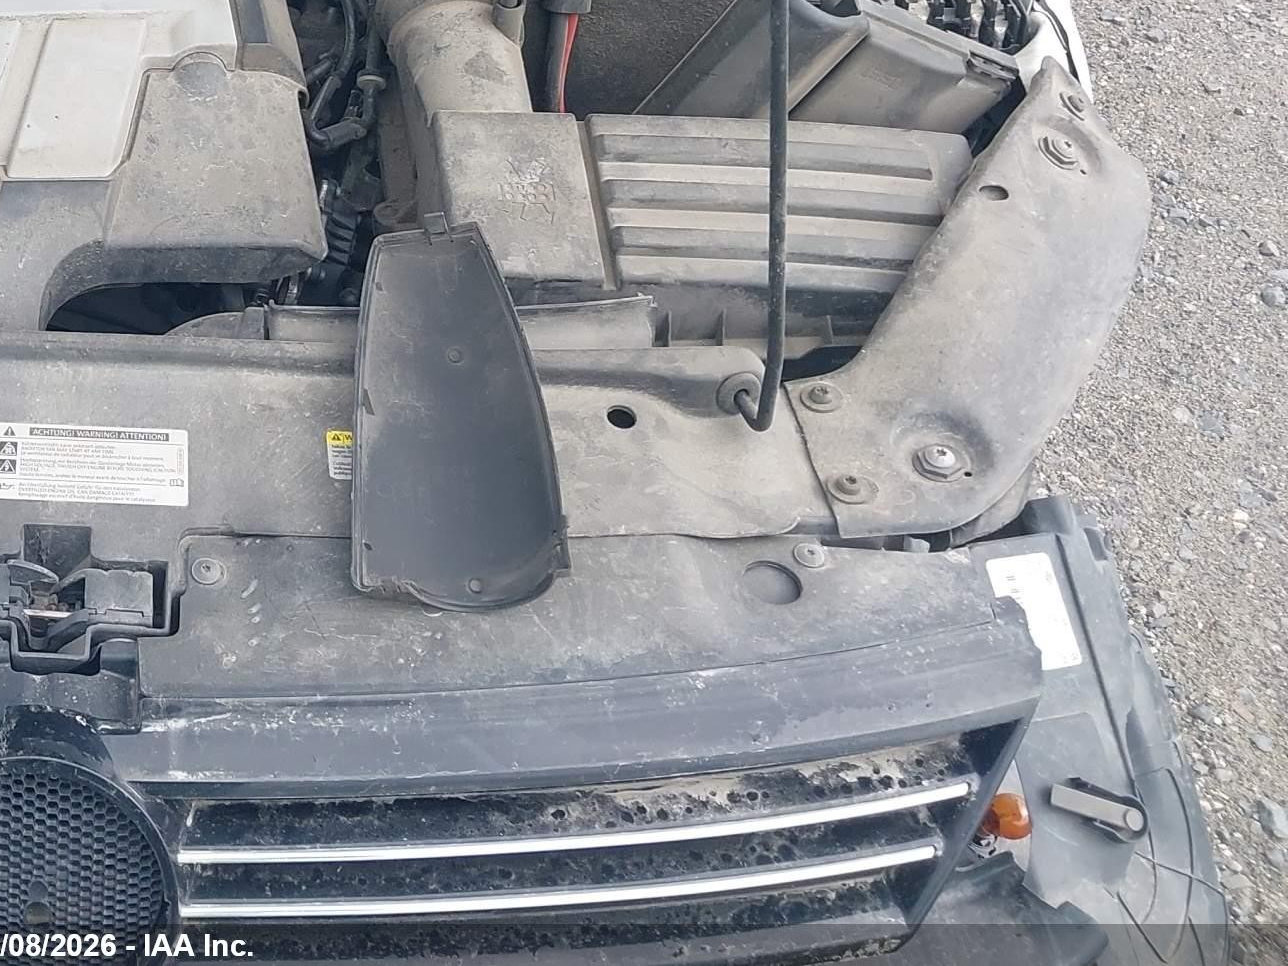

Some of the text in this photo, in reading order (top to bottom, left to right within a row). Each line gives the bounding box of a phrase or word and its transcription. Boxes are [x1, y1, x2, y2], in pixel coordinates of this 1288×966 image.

[32, 427, 167, 441] ACHTUNG! WARNING! ATTENTION!
